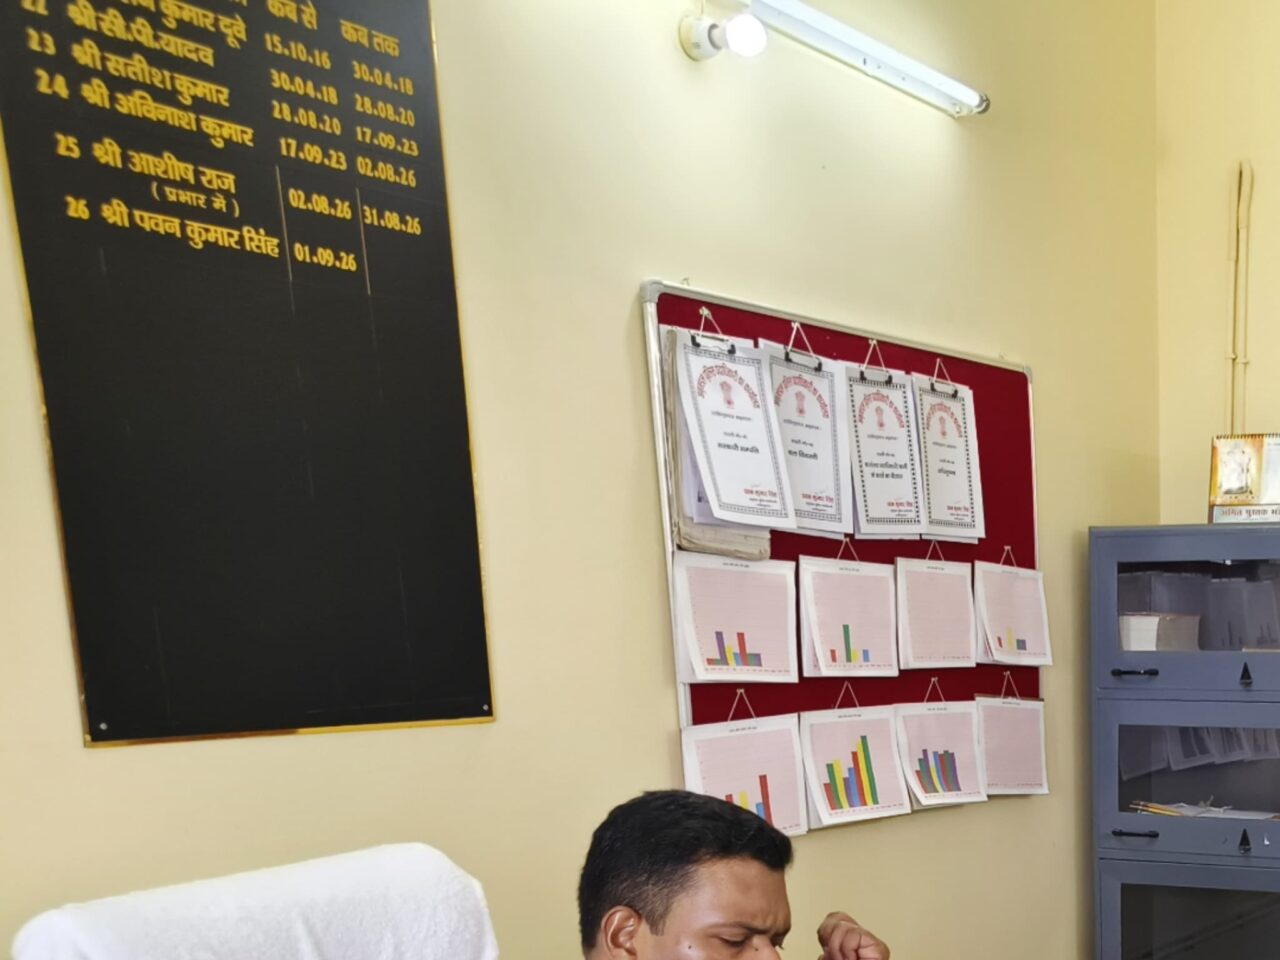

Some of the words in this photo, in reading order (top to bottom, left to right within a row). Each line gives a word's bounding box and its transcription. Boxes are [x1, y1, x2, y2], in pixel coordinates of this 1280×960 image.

[26, 26, 56, 55] 23
[71, 38, 102, 70] श्री
[103, 52, 172, 90] सतीश
[173, 72, 230, 107] कुमार
[272, 100, 342, 136] 28.08.20
[356, 126, 419, 157] 17.09.23
[67, 0, 97, 31] श्री
[269, 68, 338, 105] 30.04.18
[354, 93, 415, 127] 28.08.20
[160, 0, 216, 31] कुमार
[264, 33, 332, 70] 15.10.16
[352, 60, 414, 95] 30.04.18
[371, 30, 399, 58] तक
[35, 67, 69, 99] 24
[80, 77, 110, 109] श्री
[114, 89, 197, 132] अविनाश
[200, 115, 254, 148] कुमार
[279, 137, 347, 171] 17.09.23
[356, 155, 417, 188] 02.08.26
[54, 131, 81, 159] 25
[92, 137, 122, 168] श्री
[127, 151, 195, 184] आशीष
[198, 166, 236, 194] राज
[288, 188, 352, 220] 02.08.26
[363, 205, 422, 236] 31.08.26
[65, 195, 90, 220] 26
[100, 199, 130, 228] श्री
[132, 209, 181, 238] पवन
[184, 219, 241, 249] कुमार
[242, 226, 280, 258] सिंह
[294, 243, 357, 272] 01.09.26
